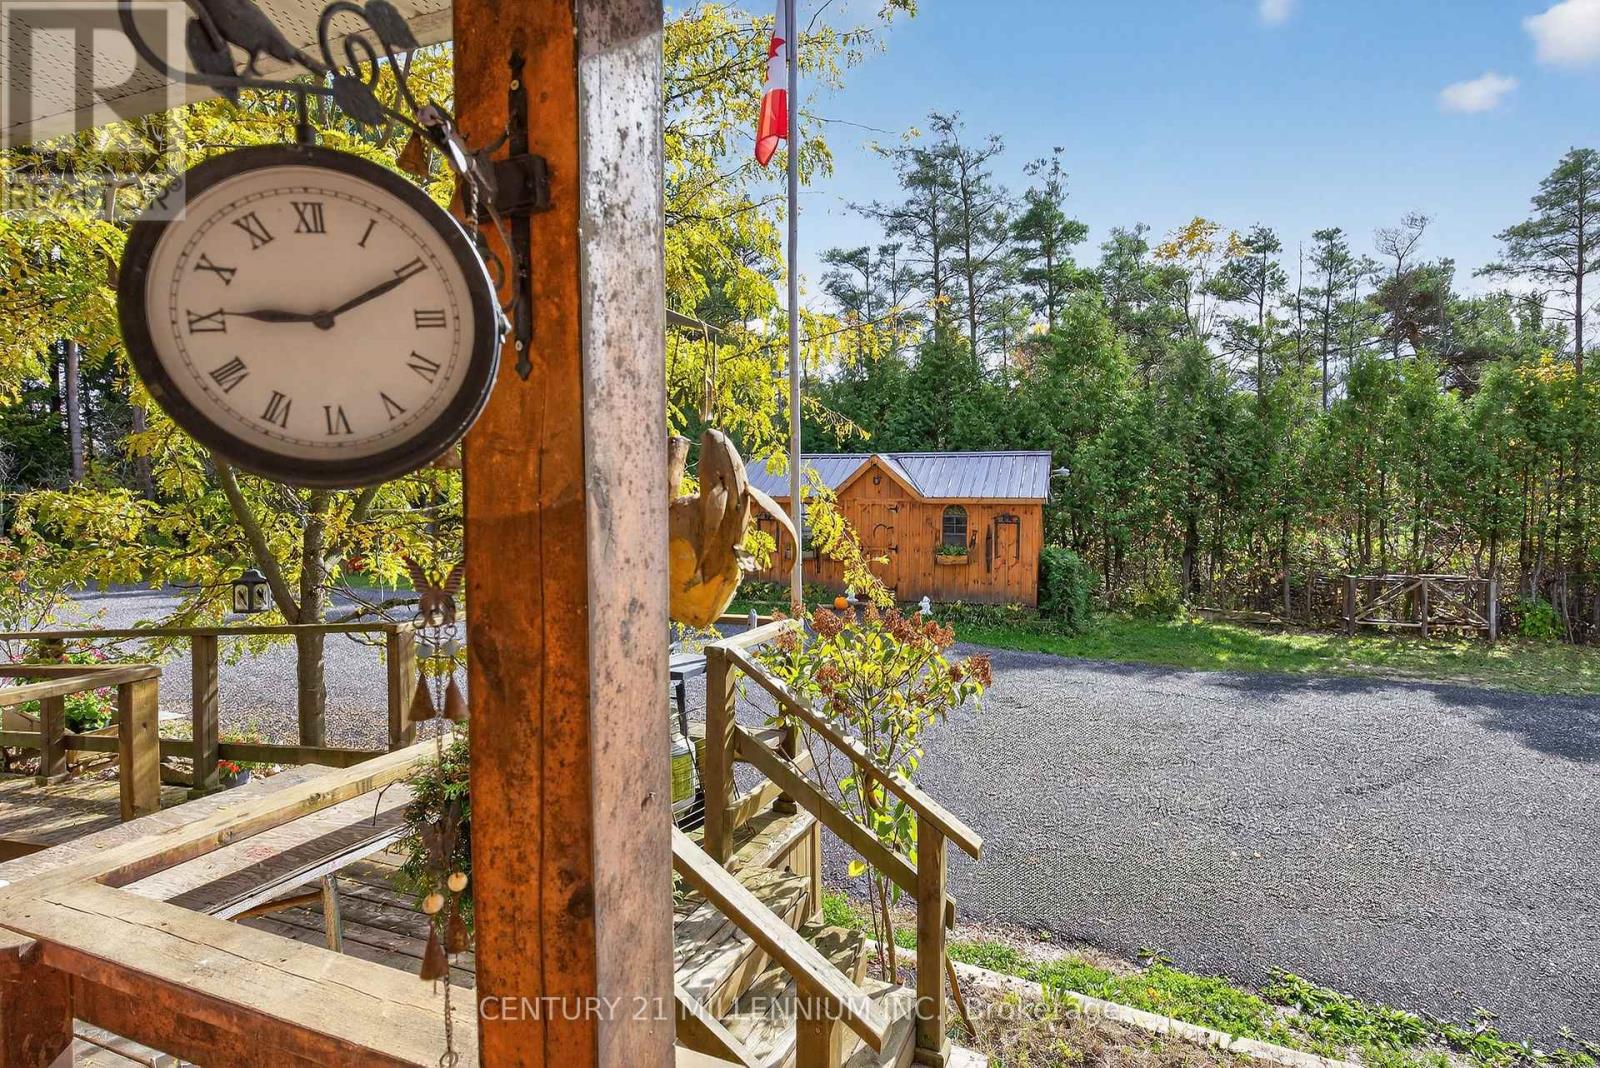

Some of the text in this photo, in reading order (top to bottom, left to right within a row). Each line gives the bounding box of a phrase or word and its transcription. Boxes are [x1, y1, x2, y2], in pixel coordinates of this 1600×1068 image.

[232, 211, 275, 250] XI
[290, 202, 326, 234] XII
[357, 218, 378, 248] I
[194, 253, 237, 285] X
[186, 308, 226, 334] IX
[414, 309, 446, 330] III
[209, 356, 249, 393] VIII
[407, 351, 441, 384] IV
[260, 390, 292, 428] VII
[323, 405, 353, 435] VI
[380, 391, 406, 420] V
